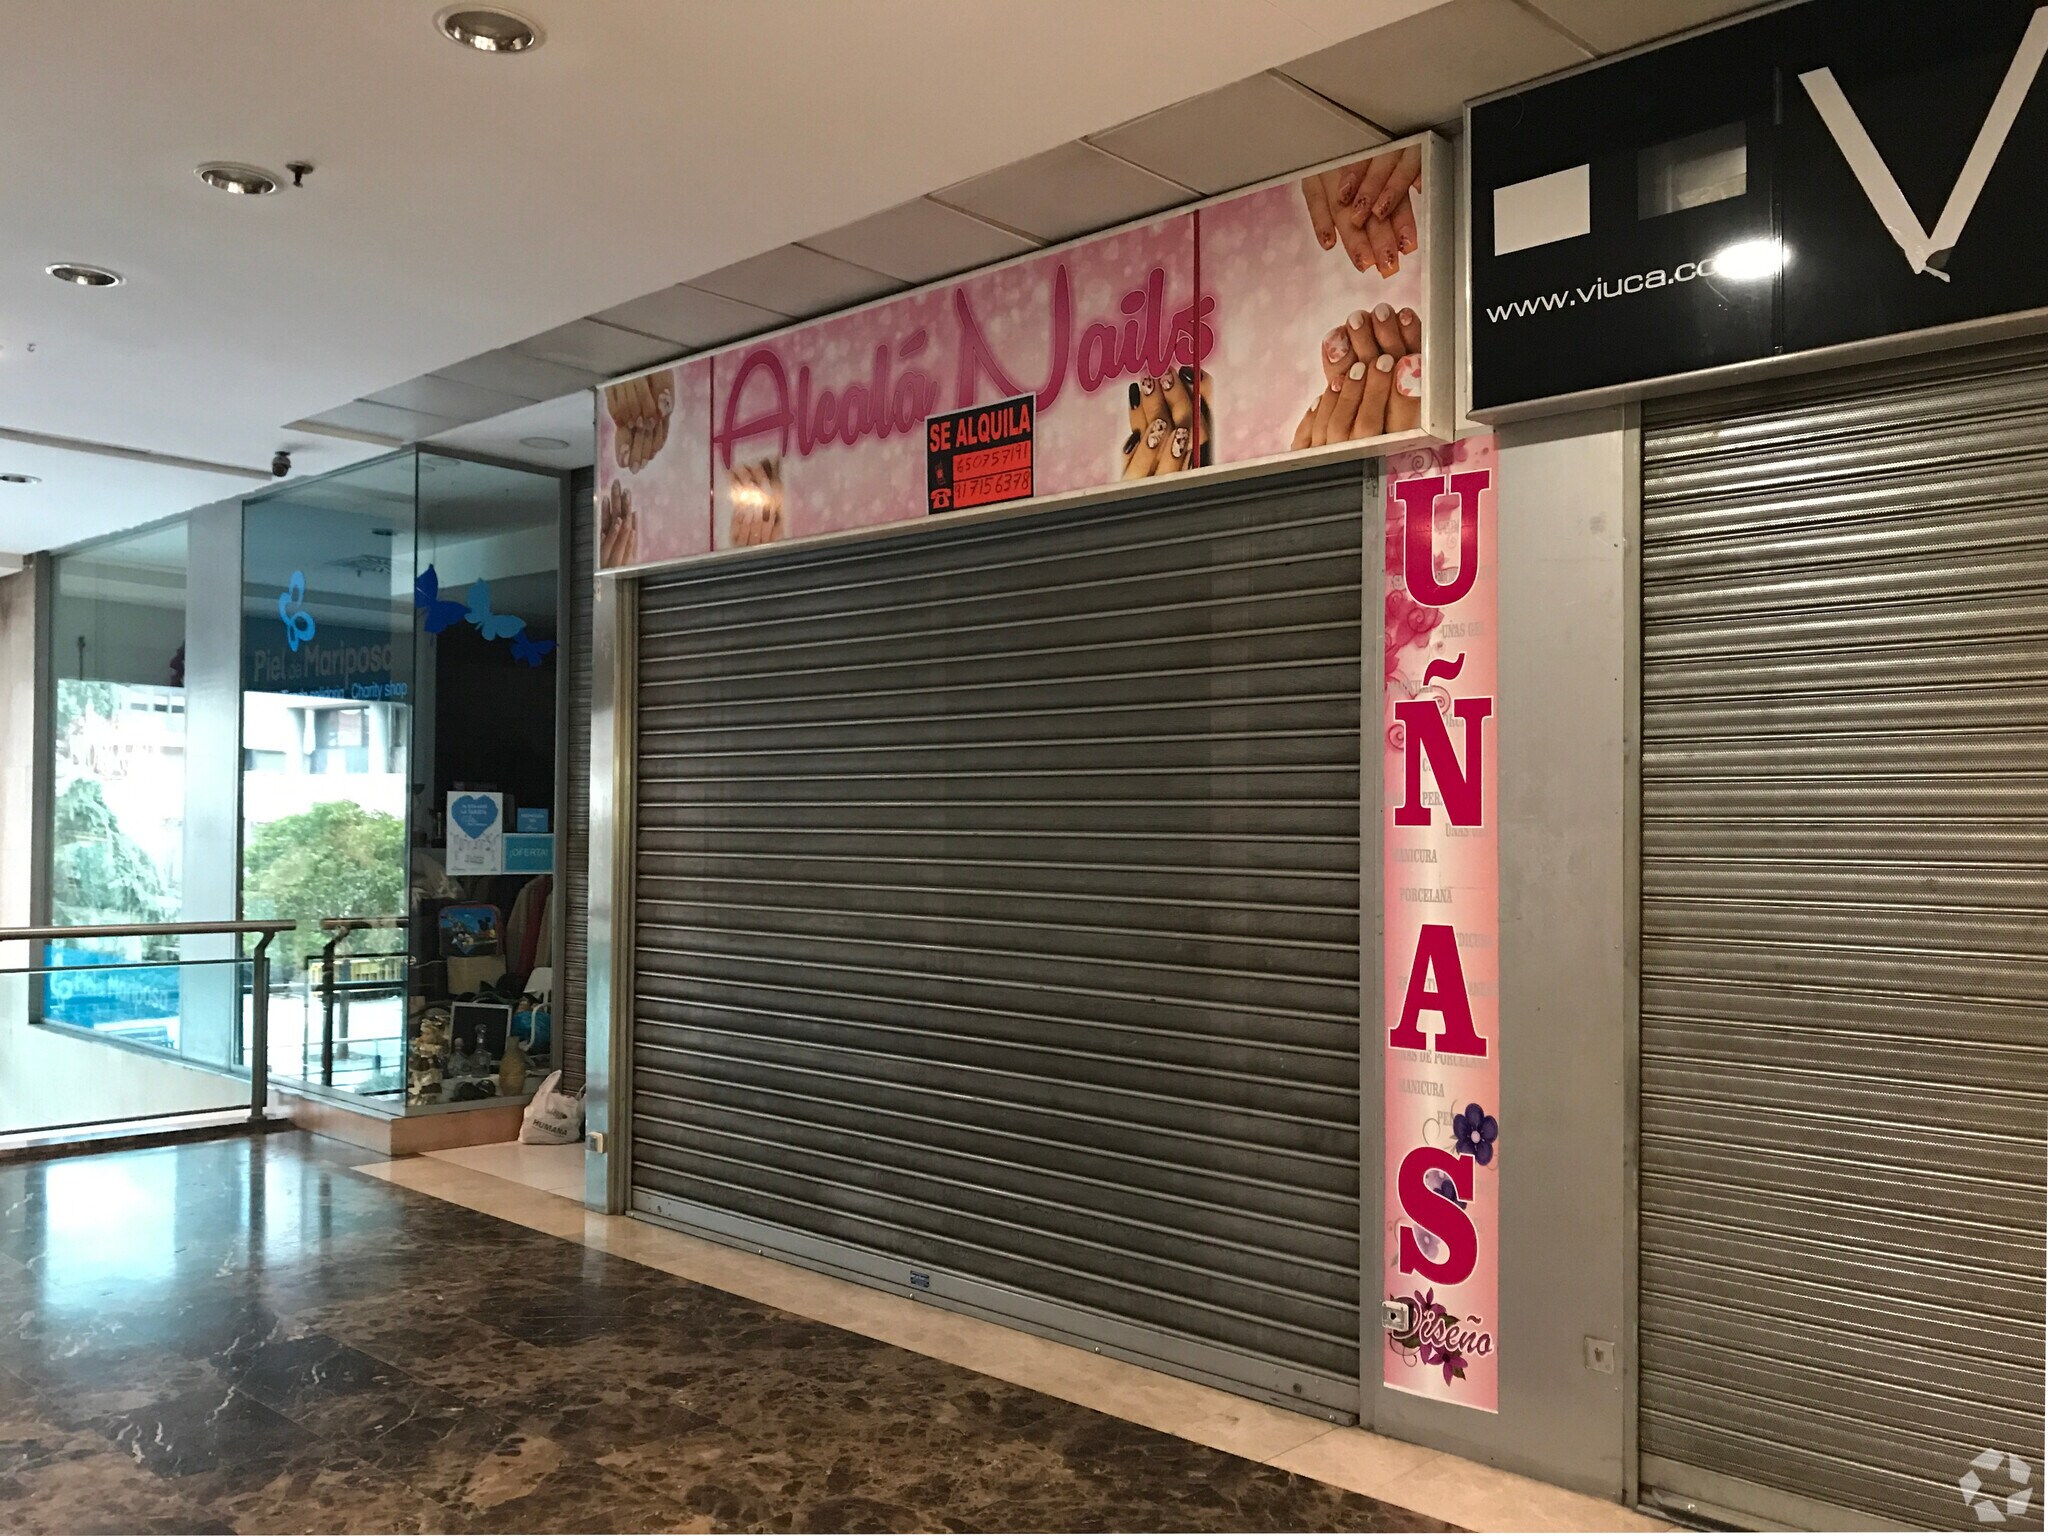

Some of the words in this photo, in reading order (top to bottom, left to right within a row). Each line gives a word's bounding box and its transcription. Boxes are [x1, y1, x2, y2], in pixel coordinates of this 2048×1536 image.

[713, 328, 938, 470] Alcalá
[955, 262, 1216, 413] Nails
[929, 421, 952, 453] SE
[955, 403, 1032, 448] ALQUILA
[253, 649, 287, 682] Piel
[384, 679, 408, 699] shop
[1400, 888, 1453, 904] PORCELANA
[1397, 1078, 1446, 1098] MANICURA
[532, 1118, 569, 1137] HUMANA
